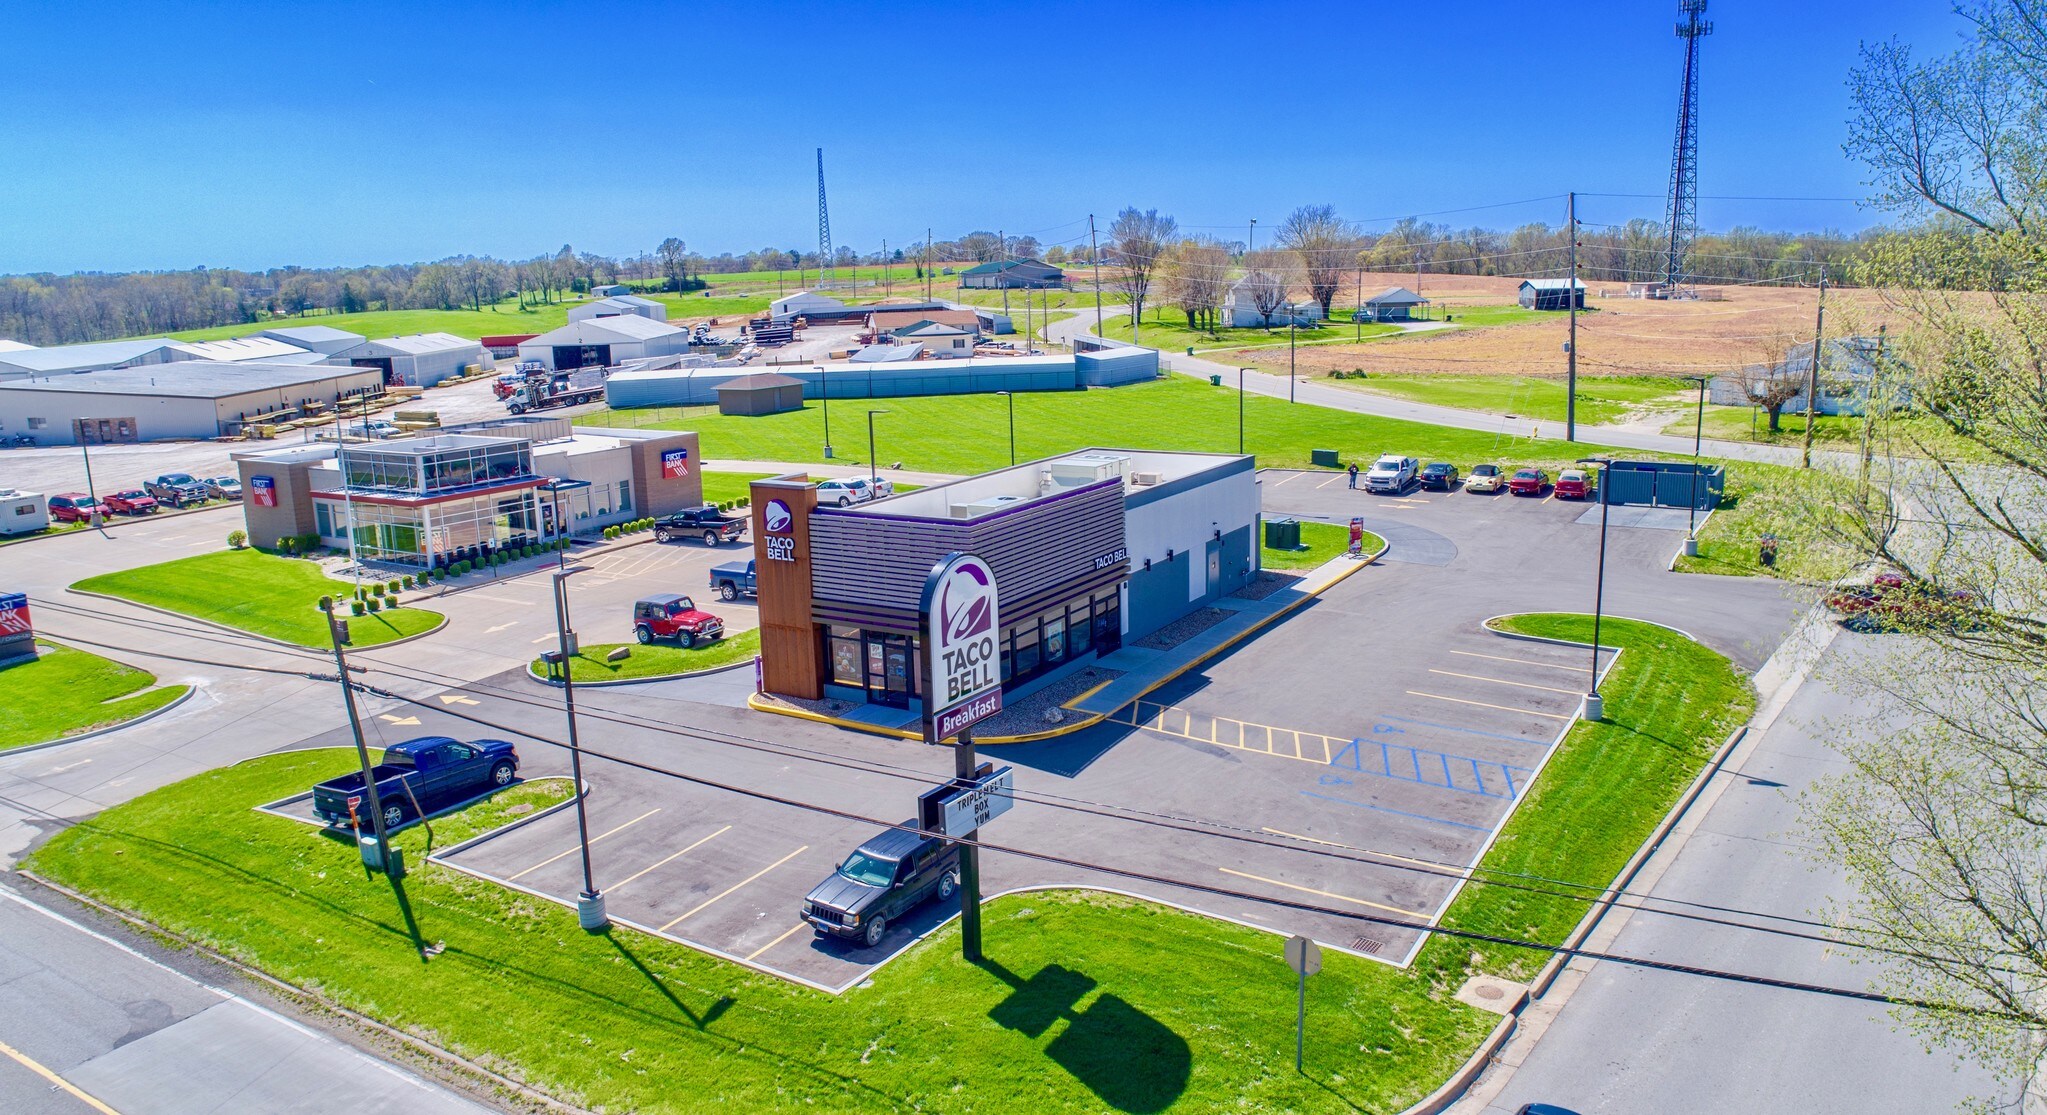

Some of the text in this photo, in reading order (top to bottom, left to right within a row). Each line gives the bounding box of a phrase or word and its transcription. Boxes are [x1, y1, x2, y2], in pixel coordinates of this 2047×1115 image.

[665, 452, 685, 462] FIRST
[666, 459, 683, 469] BANK
[252, 479, 269, 488] FIRST
[253, 487, 268, 495] BANK
[764, 535, 794, 550] TACO
[767, 548, 795, 562] BELL
[1094, 553, 1114, 570] TACO
[942, 636, 993, 677] TACO
[947, 663, 994, 703] BELL
[943, 695, 996, 734] Breakfast
[974, 797, 989, 814] BOX
[974, 809, 990, 827] YUM
